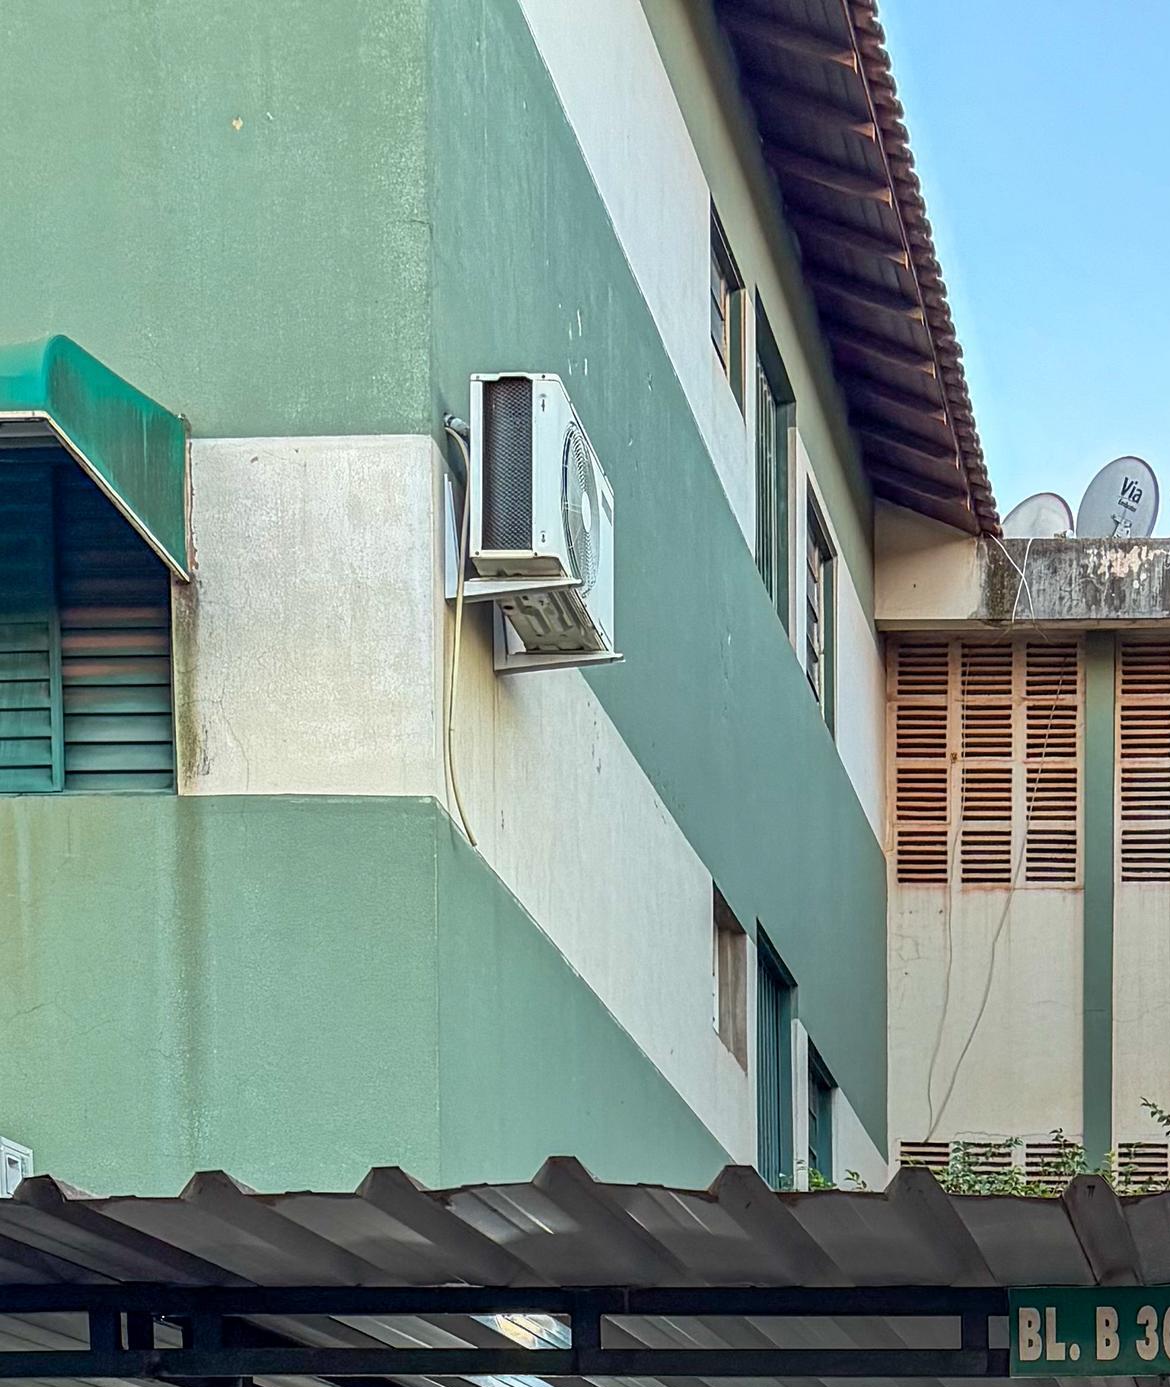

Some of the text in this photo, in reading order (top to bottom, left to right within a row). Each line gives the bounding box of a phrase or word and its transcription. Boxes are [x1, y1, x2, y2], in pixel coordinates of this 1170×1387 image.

[1121, 476, 1143, 504] Via
[1018, 1307, 1081, 1361] BL.
[1096, 1306, 1120, 1361] B
